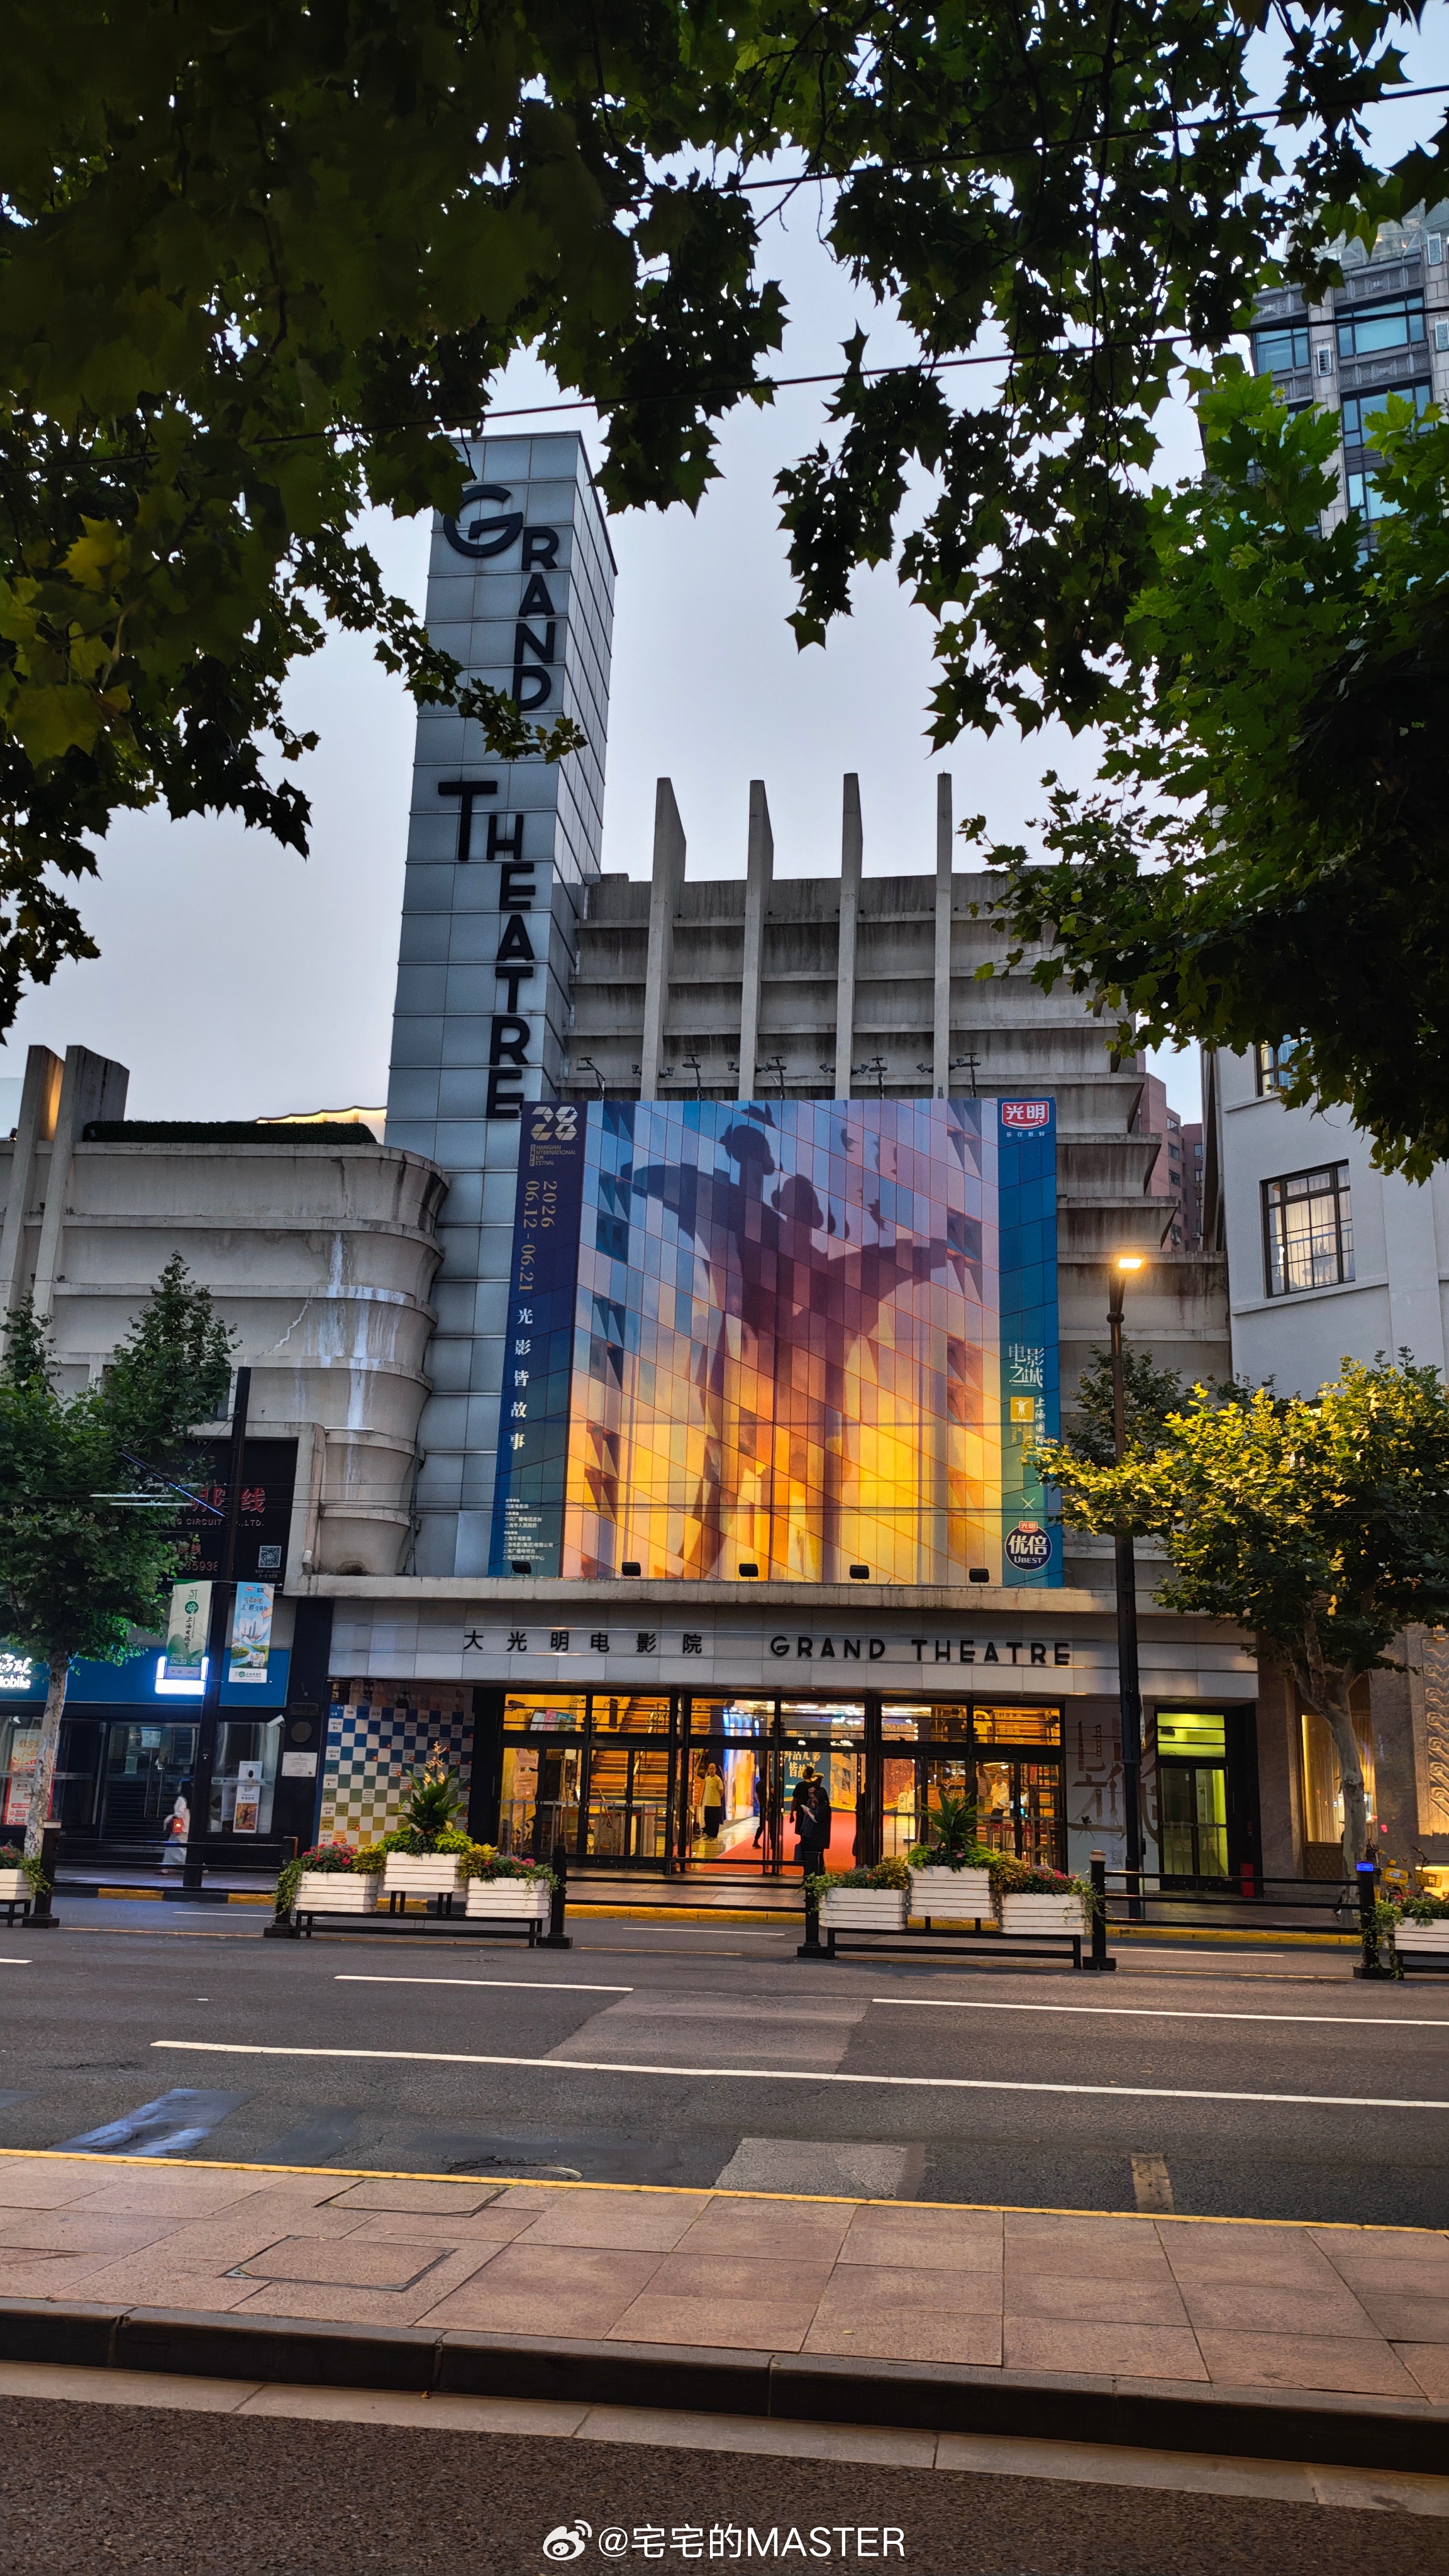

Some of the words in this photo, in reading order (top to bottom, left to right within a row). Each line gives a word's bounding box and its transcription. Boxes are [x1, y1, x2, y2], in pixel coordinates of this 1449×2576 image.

[443, 484, 559, 711] GRAND
[438, 780, 536, 1119] THEATRE
[1006, 1105, 1045, 1119] 光明
[541, 1180, 558, 1228] 2026
[508, 1307, 533, 1450] 光影皆故事
[1008, 1535, 1048, 1555] 优倍
[464, 1630, 702, 1654] 大光明电影院
[770, 1635, 886, 1659] GRAND
[911, 1639, 1070, 1666] THEATRE
